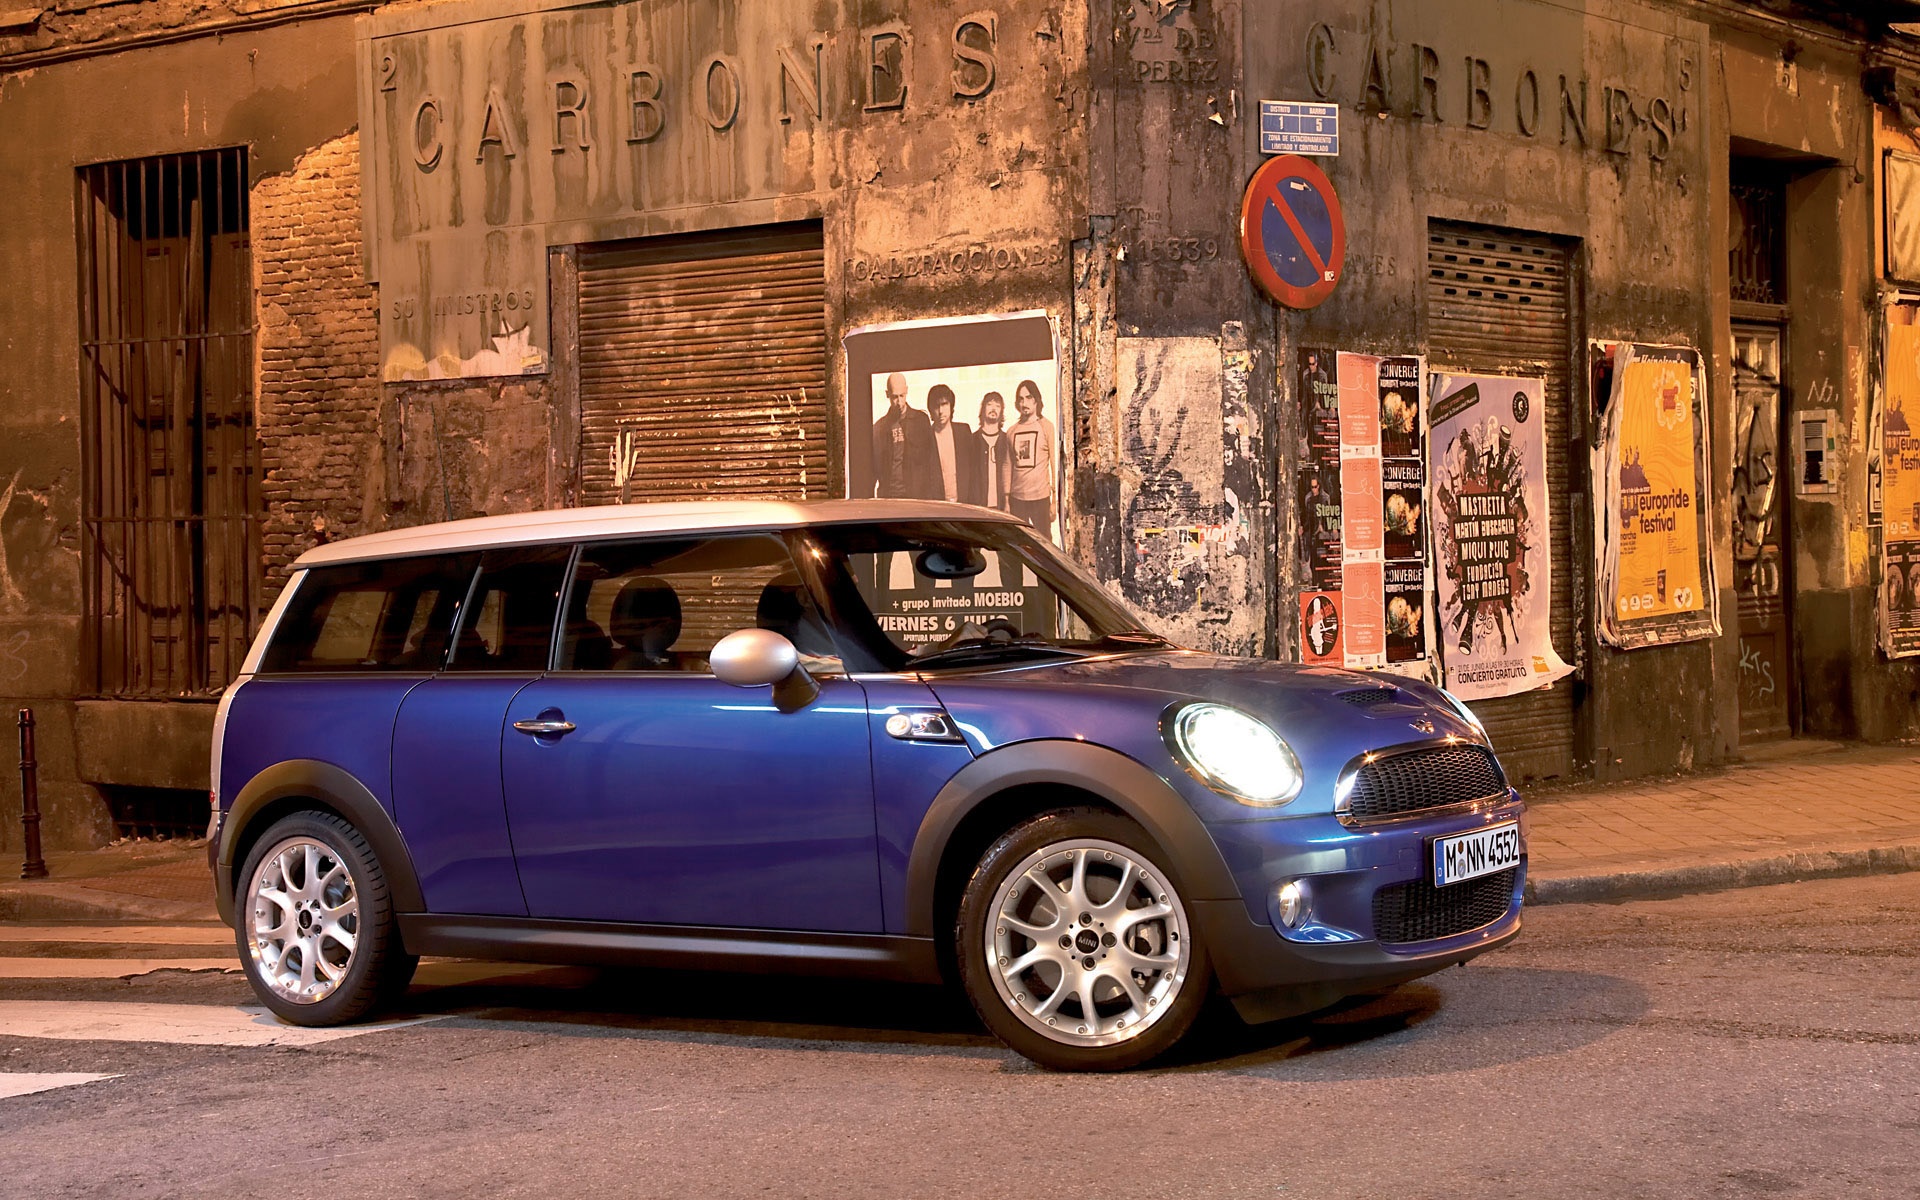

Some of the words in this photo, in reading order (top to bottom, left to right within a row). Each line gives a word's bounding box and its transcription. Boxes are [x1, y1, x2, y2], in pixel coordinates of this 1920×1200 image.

[1174, 27, 1214, 50] DE
[380, 53, 398, 92] 2
[1134, 60, 1219, 83] PEREZ
[412, 9, 998, 173] CARBONES
[1306, 20, 1672, 161] CARBONES
[1270, 105, 1290, 113] DISTRITO
[1309, 107, 1326, 115] BARRIO
[1279, 115, 1284, 130] 1
[1315, 118, 1323, 132] 5
[1290, 135, 1331, 144] ESTACIONAMIENTO
[1271, 143, 1293, 151] LIMITADO
[1299, 144, 1329, 152] CONTROLADO
[1380, 364, 1418, 378] CONVERGE
[1323, 395, 1338, 409] Vai
[1383, 466, 1421, 480] CONVERGE
[1460, 496, 1506, 516] MASTRETTA
[1640, 488, 1689, 514] europride
[1316, 503, 1340, 517] Steve
[1326, 517, 1341, 530] Vai
[1640, 511, 1675, 533] festival
[1461, 541, 1487, 561] MIQUI
[1489, 540, 1509, 559] PUIG
[1385, 568, 1423, 582] CONVERGE
[902, 599, 930, 612] grupo
[932, 596, 971, 608] invitado
[974, 592, 1024, 606] MOEBIO
[877, 616, 939, 631] VIERNES
[945, 616, 956, 630] 6
[903, 634, 928, 642] APERTURA
[1458, 670, 1494, 684] CONCIERTO
[1495, 667, 1527, 680] GRATUITO
[1446, 843, 1456, 878] M
[1466, 837, 1485, 873] NN
[1488, 829, 1518, 866] 4552
[1078, 936, 1097, 948] MINI
